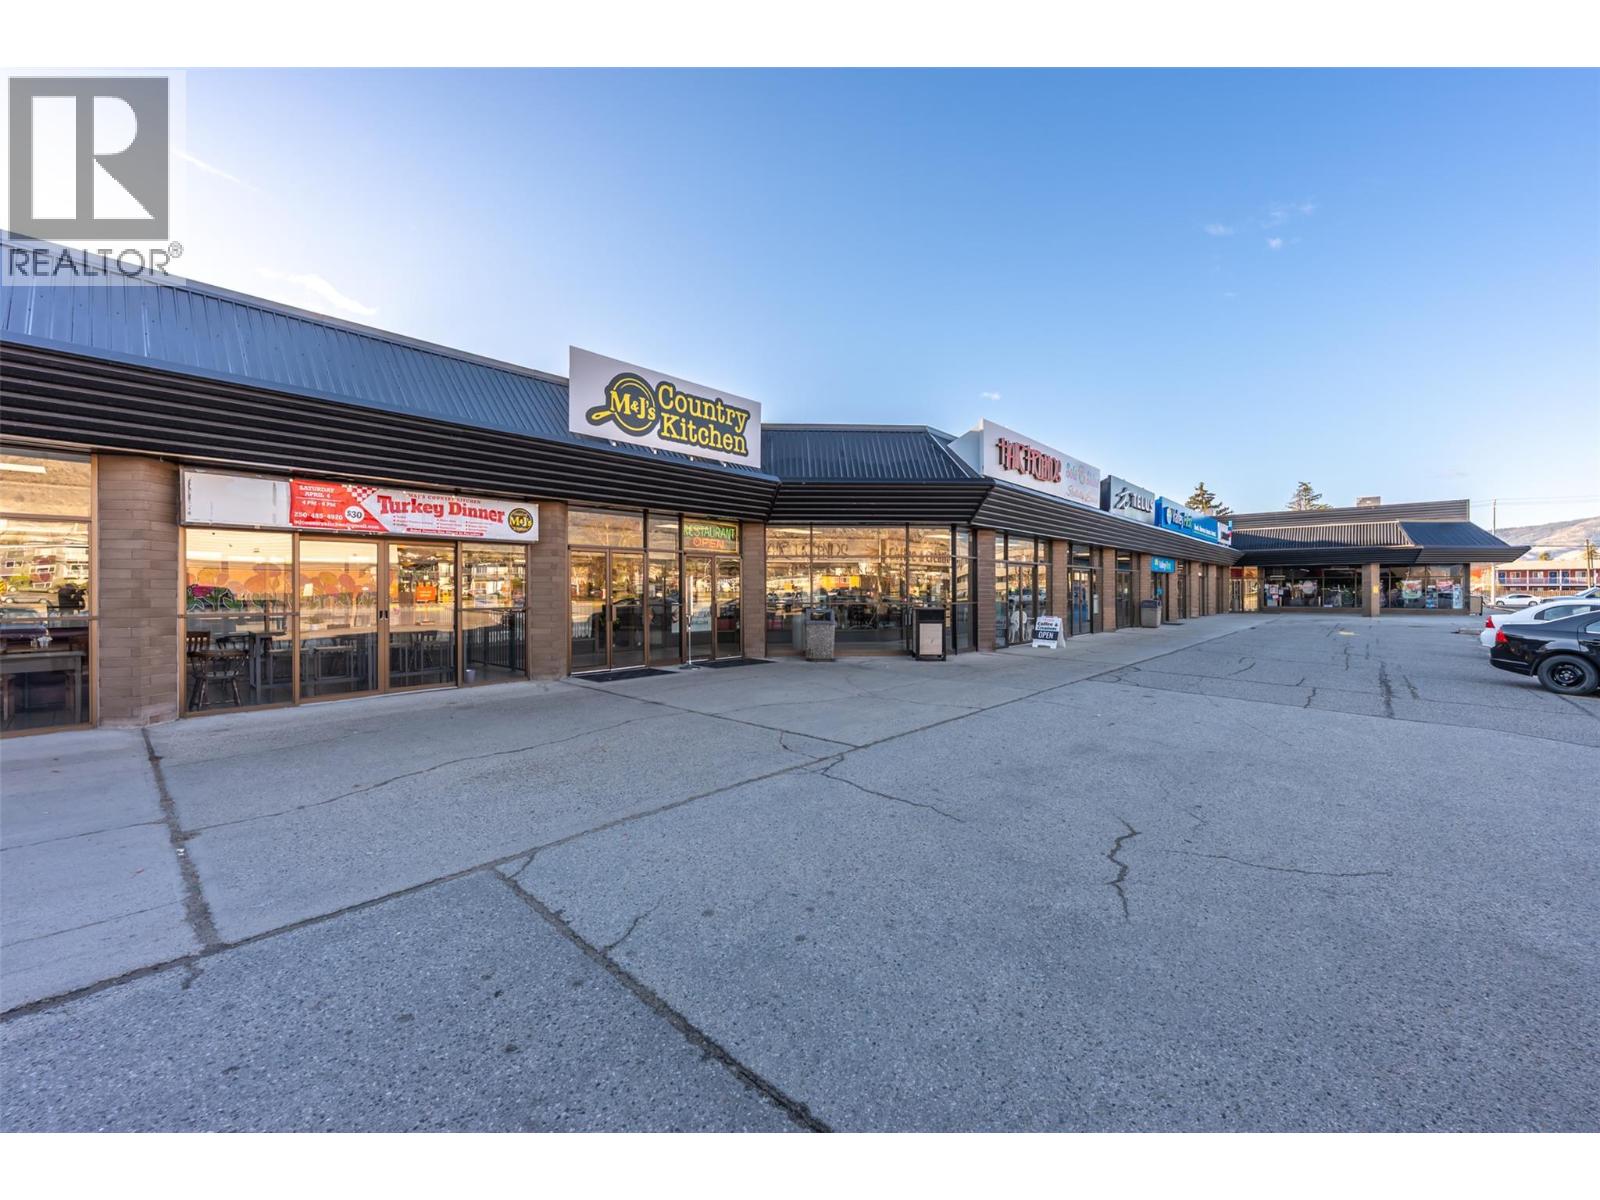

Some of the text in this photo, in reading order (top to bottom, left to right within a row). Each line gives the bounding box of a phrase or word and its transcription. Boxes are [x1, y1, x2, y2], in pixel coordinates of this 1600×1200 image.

[609, 389, 656, 420] M&J's
[658, 384, 748, 433] Country
[661, 412, 746, 454] Kitchen
[376, 495, 444, 518] Turkey
[449, 501, 505, 524] Dinner
[1129, 493, 1154, 513] TELUS
[346, 510, 362, 519] $30
[684, 525, 735, 540] RESTAURANT
[693, 537, 725, 549] OPEN
[1038, 631, 1054, 639] OPEN
